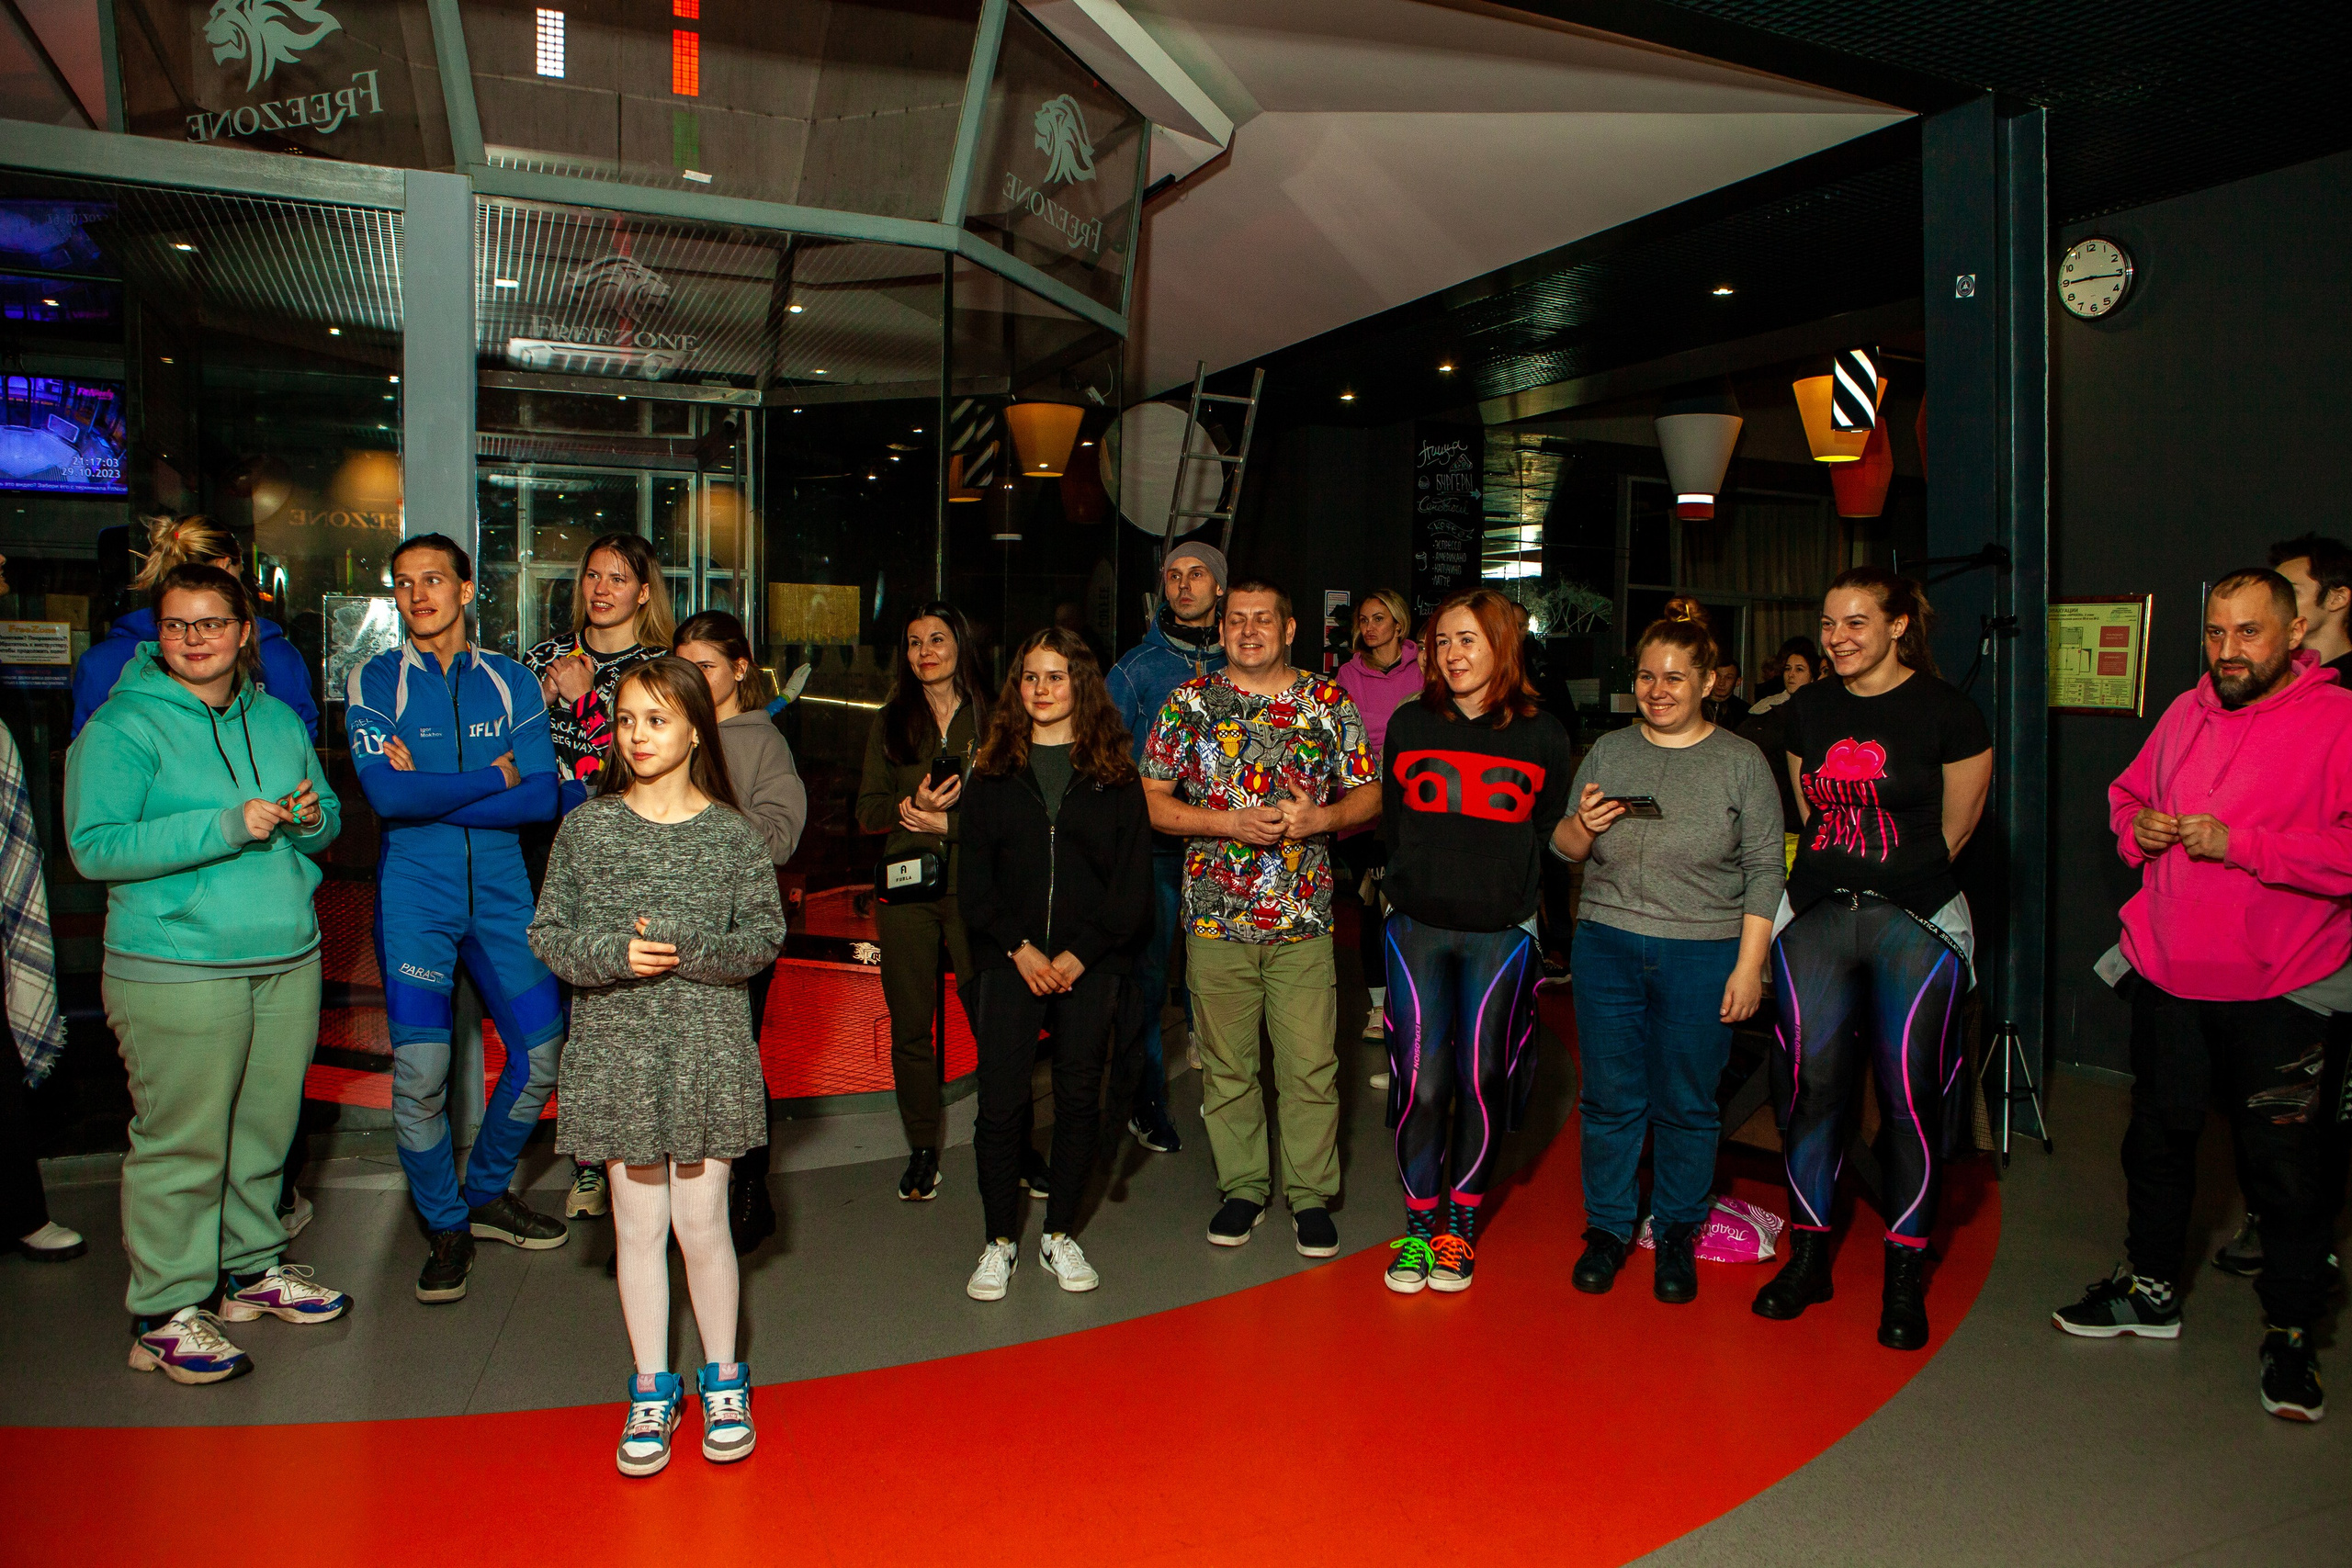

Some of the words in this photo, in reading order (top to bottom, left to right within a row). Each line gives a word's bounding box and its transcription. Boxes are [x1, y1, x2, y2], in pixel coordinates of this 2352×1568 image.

[2086, 243, 2096, 253] 12
[2110, 254, 2119, 263] 2
[2065, 264, 2074, 273] 10
[2063, 279, 2070, 288] 9
[2113, 284, 2120, 292] 4
[2067, 293, 2075, 301] 8
[2103, 297, 2111, 306] 5
[2077, 302, 2084, 310] 7
[2090, 303, 2098, 312] 6
[73, 457, 119, 468] 21:17:03
[62, 467, 121, 478] 29.10.2023
[469, 715, 506, 737] IFLY
[552, 732, 571, 746] BIG
[1413, 1024, 1421, 1070] EXPLOSION
